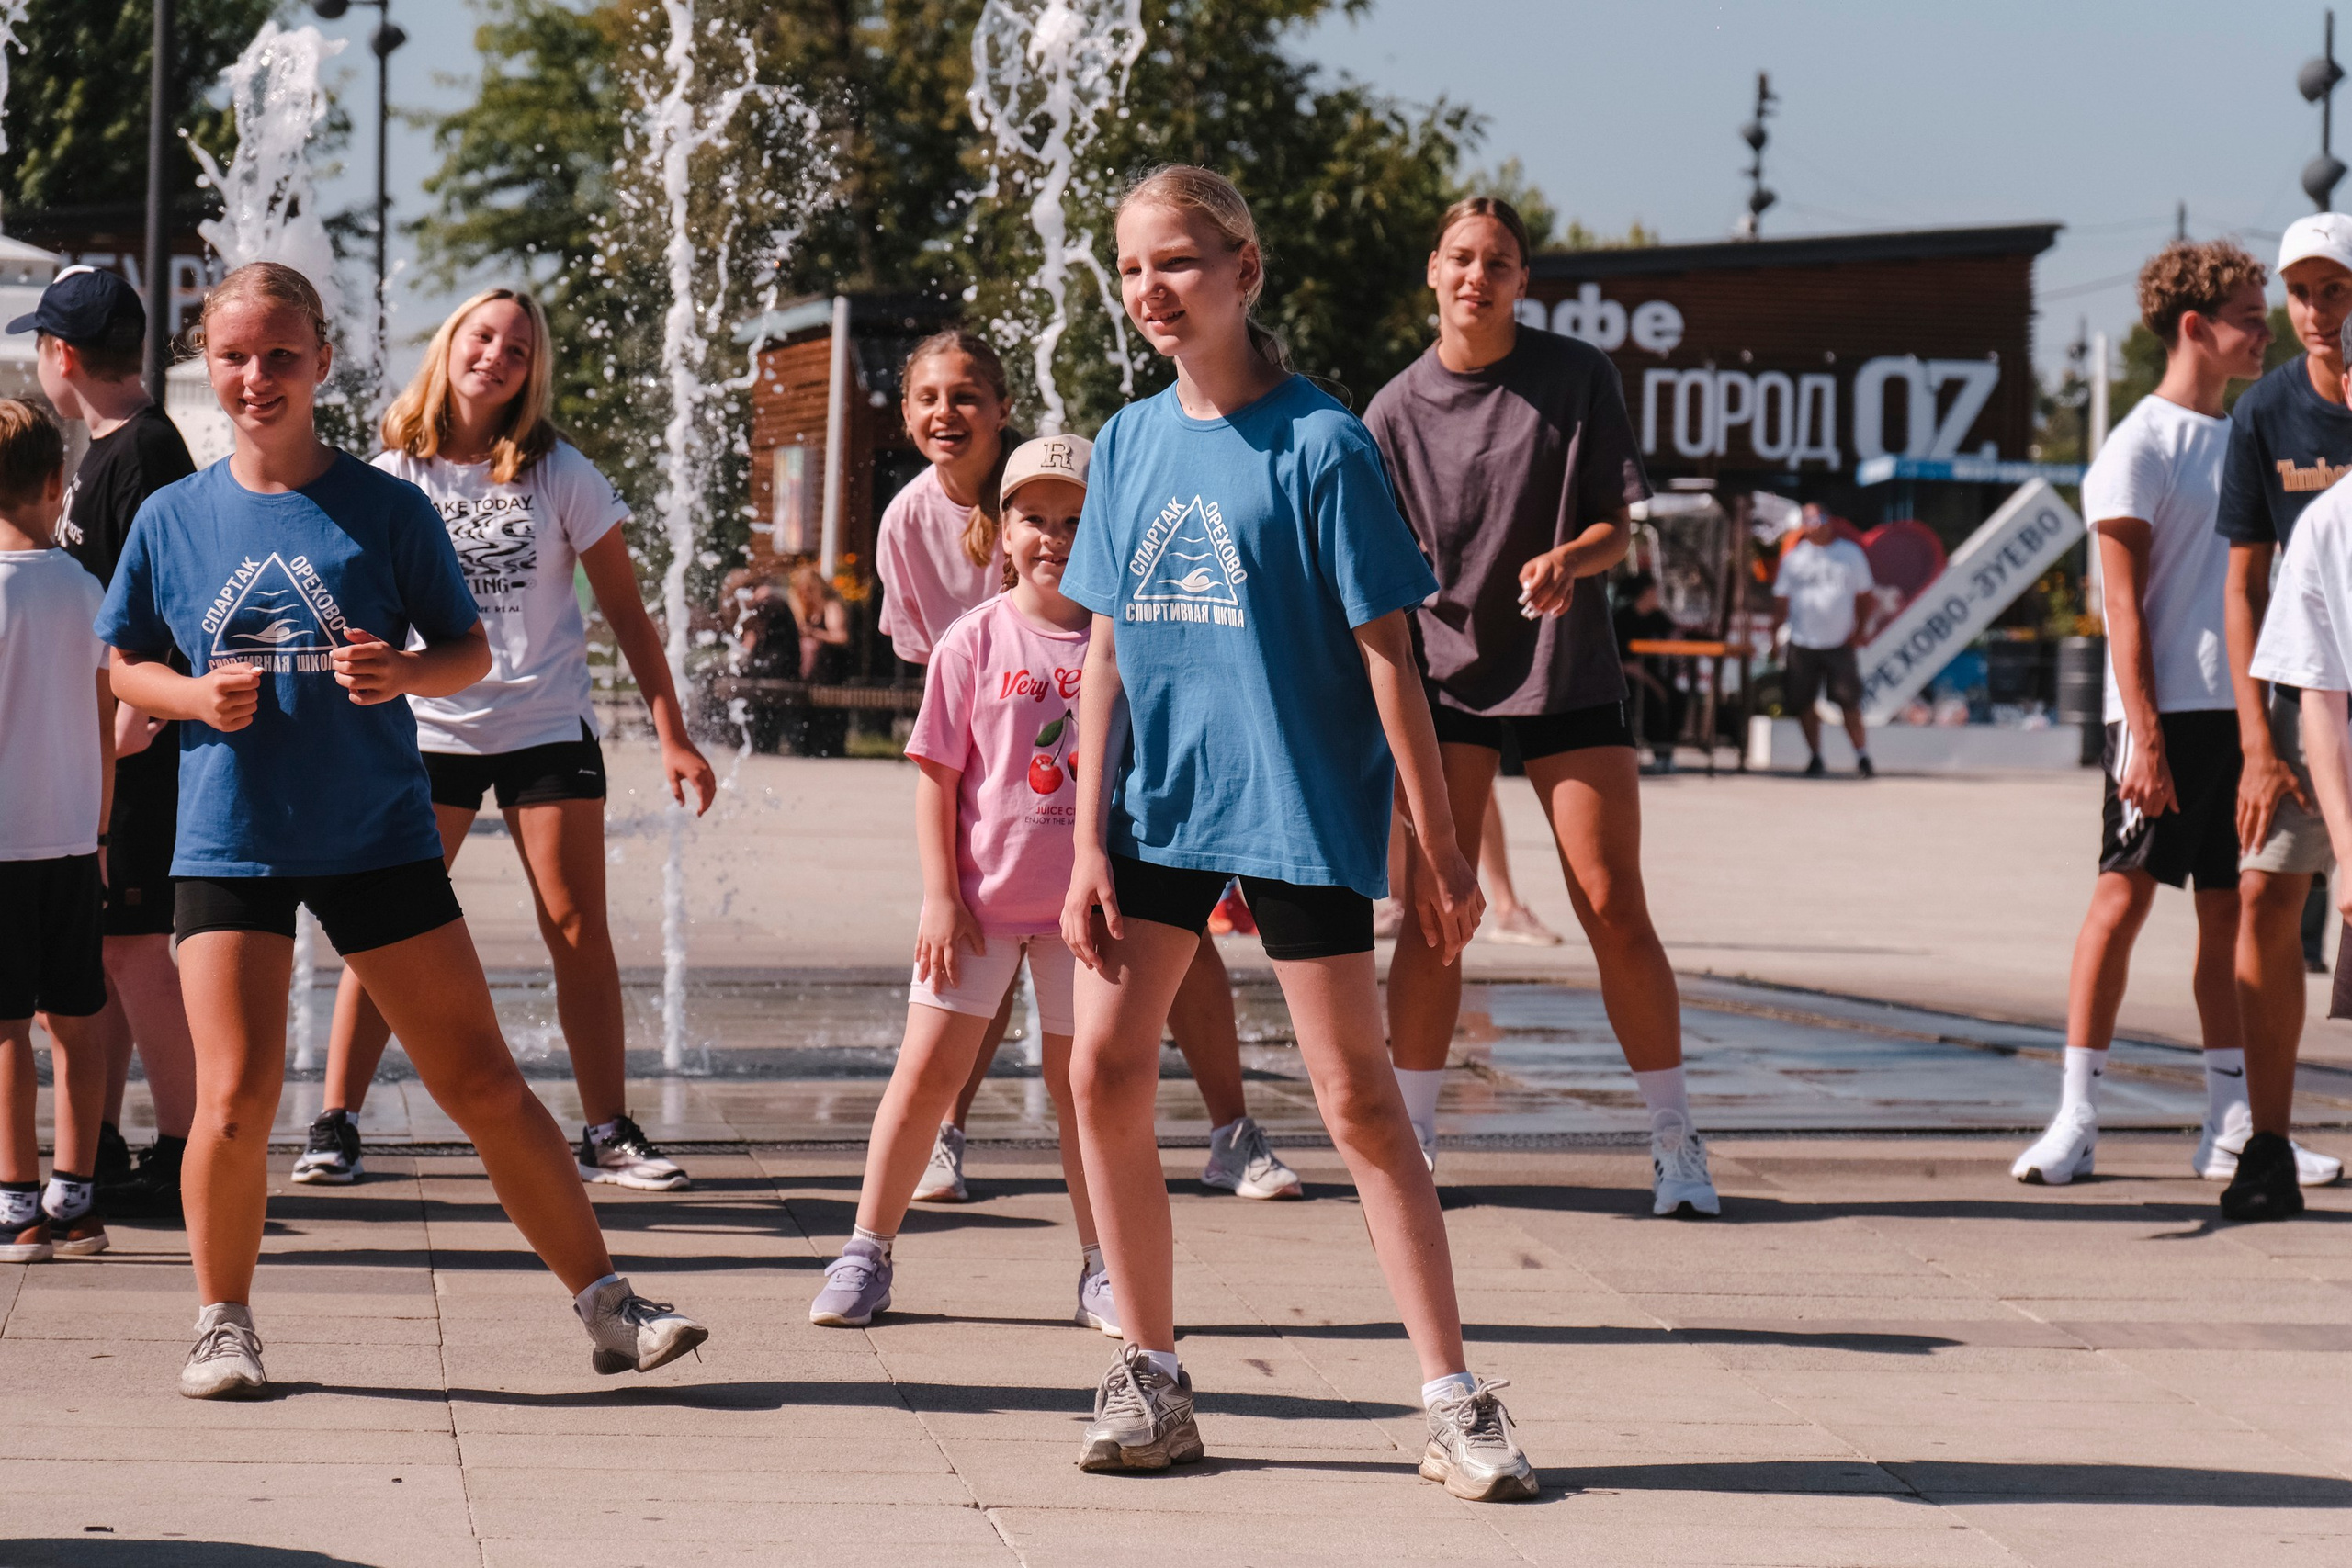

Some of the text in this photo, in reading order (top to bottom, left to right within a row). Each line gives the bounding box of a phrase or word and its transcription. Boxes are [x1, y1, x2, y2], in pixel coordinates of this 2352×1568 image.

[1512, 282, 1685, 353] афе
[1643, 367, 1841, 470] ГОРОД
[1040, 442, 1075, 471] R
[434, 495, 534, 514] AKE TODAY
[1129, 496, 1186, 576] СПАРТАК
[1205, 501, 1248, 585] ОРЕХОВО
[201, 556, 260, 634] СПАРТАК
[289, 555, 346, 632] ОРЕХОВО
[467, 578, 509, 594] ING
[1125, 603, 1209, 623] СПОРТИВНАЯ
[1860, 509, 2063, 705] РЕХОВО-ЗУЕВО
[296, 653, 334, 671] ШКОЛ
[1000, 669, 1049, 703] Very
[1024, 816, 1050, 825] ENJOY
[1053, 817, 1065, 825] THE
[1035, 806, 1063, 816] JUICE
